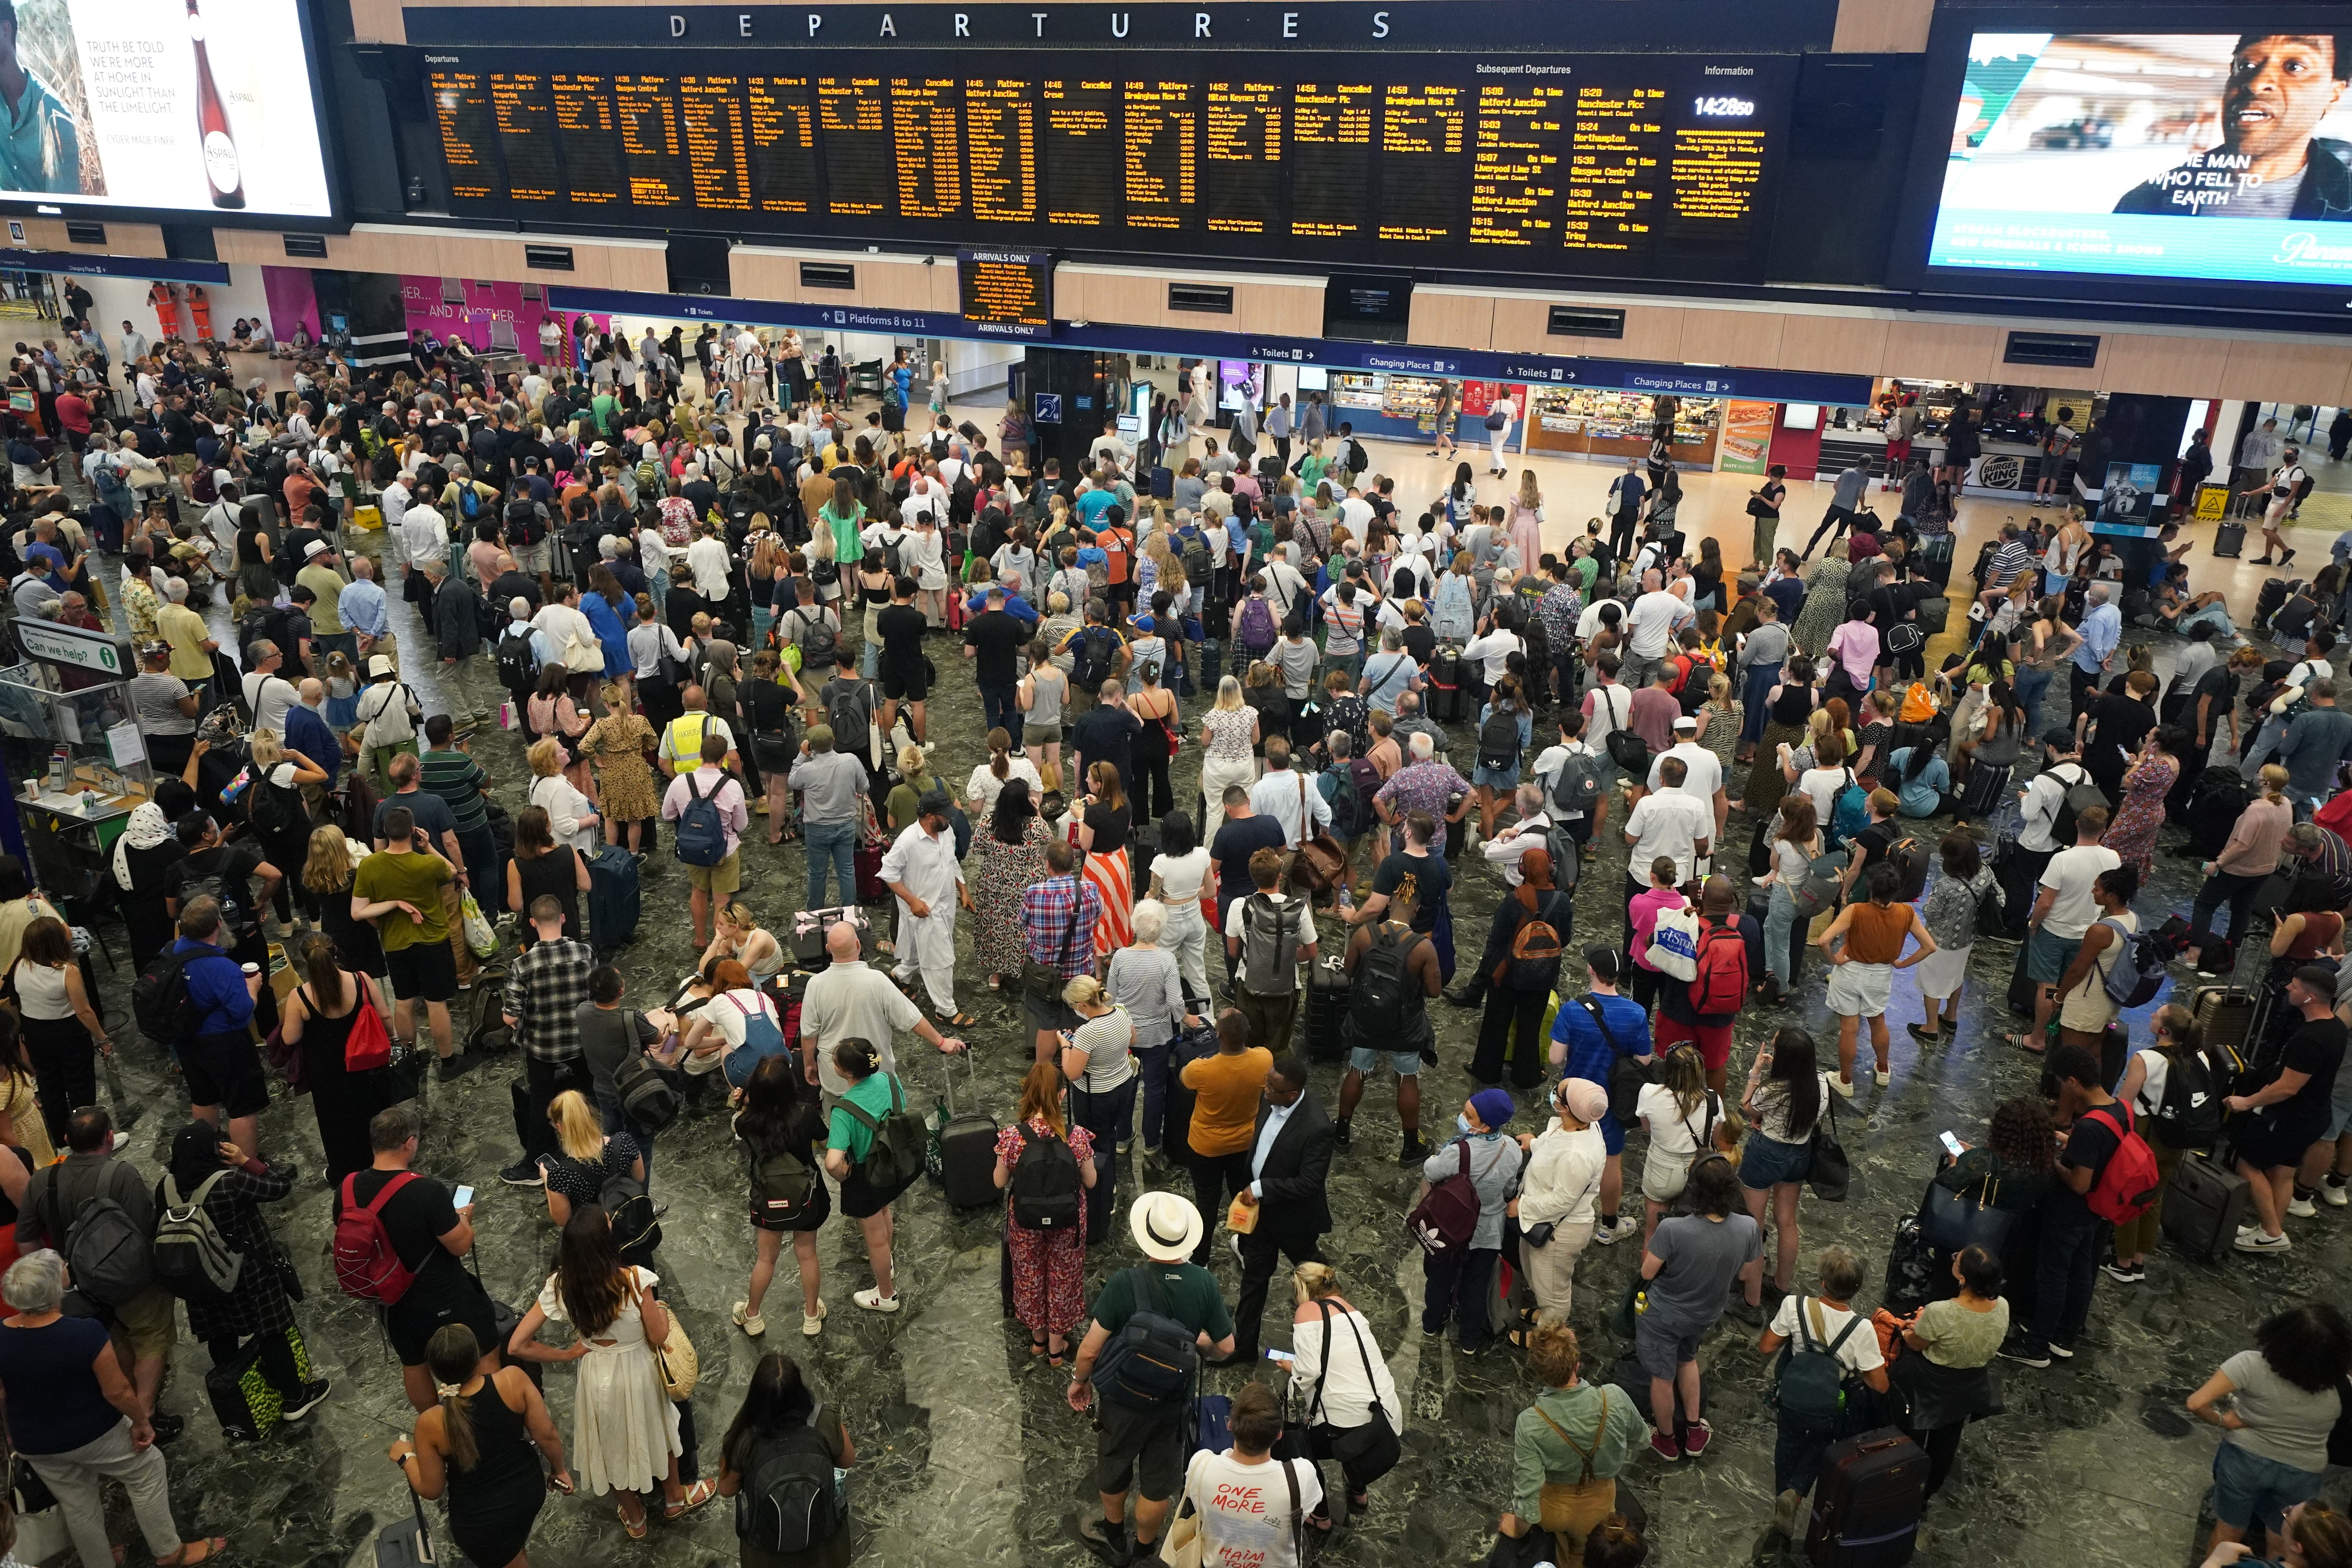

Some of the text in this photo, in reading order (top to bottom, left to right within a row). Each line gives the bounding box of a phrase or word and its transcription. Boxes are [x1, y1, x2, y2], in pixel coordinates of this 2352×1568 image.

[670, 12, 1389, 38] DEPARTURES
[87, 41, 164, 53] TRUTH BE TOLD
[90, 56, 154, 68] WE'RE MORE
[425, 55, 459, 64] Departures
[1476, 64, 1571, 75] Subsequent Departures
[1705, 66, 1753, 75] Information
[94, 72, 151, 83] AT HOME IN
[96, 87, 175, 98] SUNLIGHT THAN
[100, 102, 174, 114] THE LIMELIGHT.
[132, 135, 151, 144] MADE
[154, 136, 175, 145] FINER
[2207, 154, 2251, 169] MAN
[2148, 171, 2263, 196] WHO FELL TO
[2172, 190, 2230, 214] EARTH
[973, 252, 1030, 263] ARRIVALS ONLY
[430, 305, 453, 318] AND
[849, 313, 926, 327] Platforms 8 to 11
[978, 324, 1034, 334] ARRIVALS ONLY
[1262, 348, 1289, 358] Toilets
[1370, 357, 1430, 369] Changing Places
[1518, 368, 1548, 377] Toilets
[1634, 377, 1701, 389] Changing Places
[1984, 462, 2018, 474] BURGER
[1984, 468, 2019, 483] KING
[26, 638, 88, 662] Can we help?
[1412, 1227, 1435, 1256] adidas
[1218, 1484, 1262, 1499] ONE
[1212, 1494, 1265, 1513] MORE
